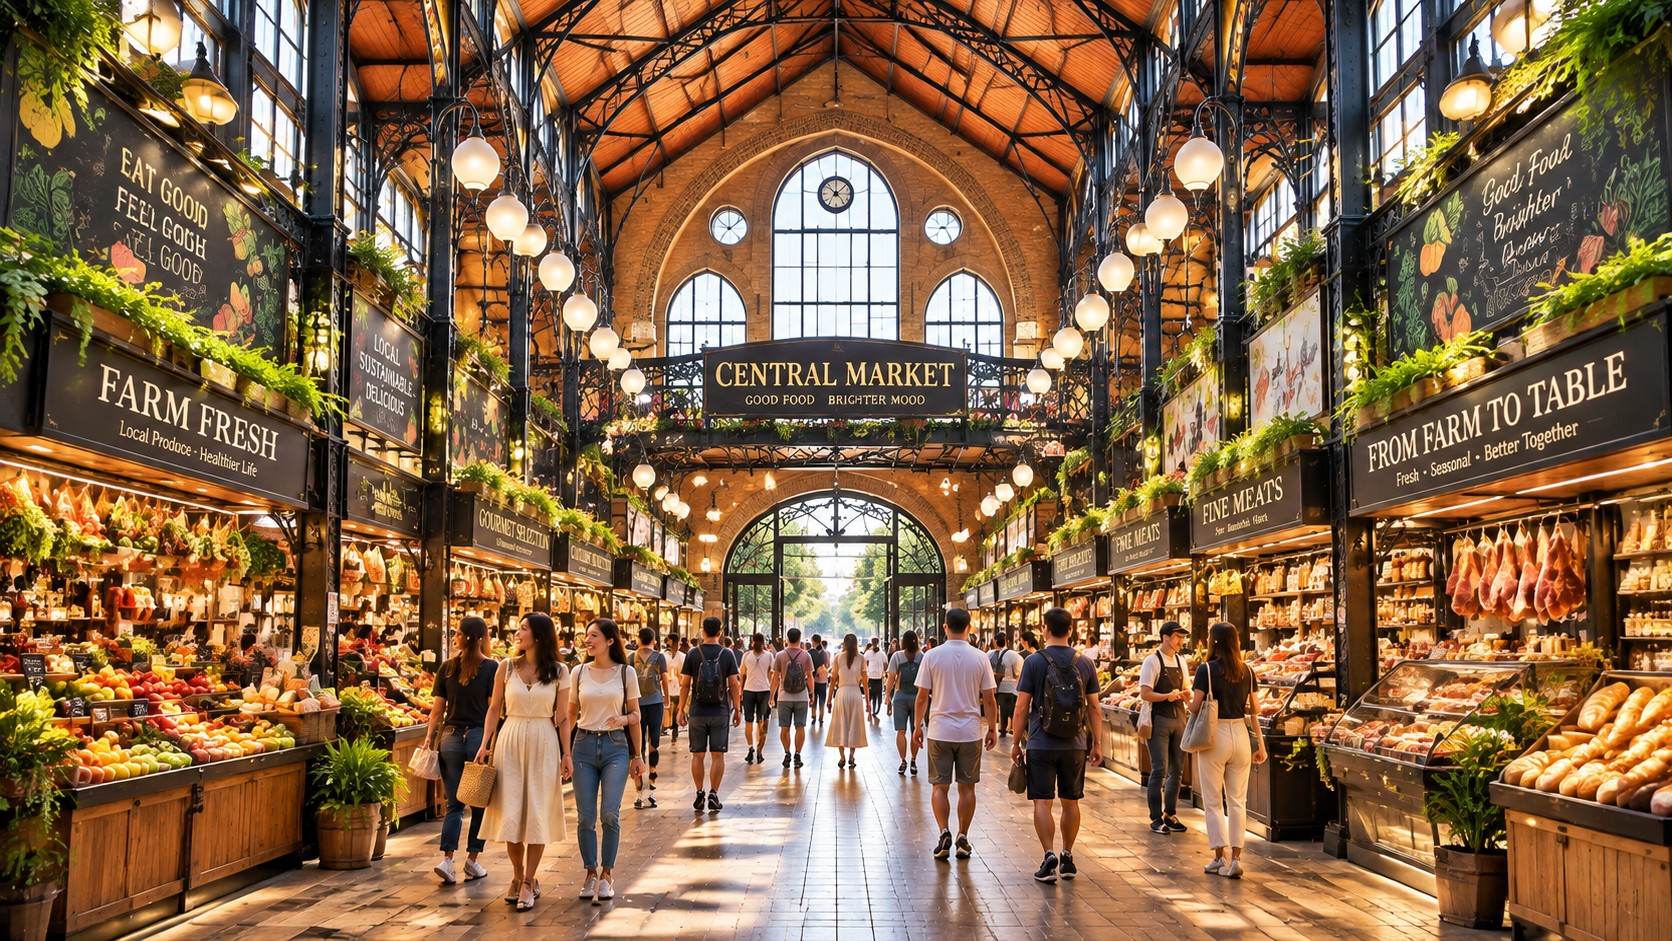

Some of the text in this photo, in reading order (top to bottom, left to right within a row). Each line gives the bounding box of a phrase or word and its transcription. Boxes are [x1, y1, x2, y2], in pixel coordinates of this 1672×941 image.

[120, 146, 157, 195] EAT
[1528, 132, 1573, 187] Food
[374, 333, 401, 367] LOCAL
[715, 361, 955, 388] CENTRAL MARKET
[98, 363, 279, 462] FARM FRESH
[745, 394, 925, 406] GOOD FOOD BRIGHTER MOOD
[1367, 350, 1627, 473] FROM FARM TO TABLE
[119, 420, 149, 444] Local
[241, 459, 258, 478] Life
[1396, 468, 1420, 488] Fresh
[1484, 440, 1520, 462] Better
[1522, 421, 1579, 451] Together
[1202, 496, 1230, 525] FINE
[1232, 475, 1284, 516] MEATS
